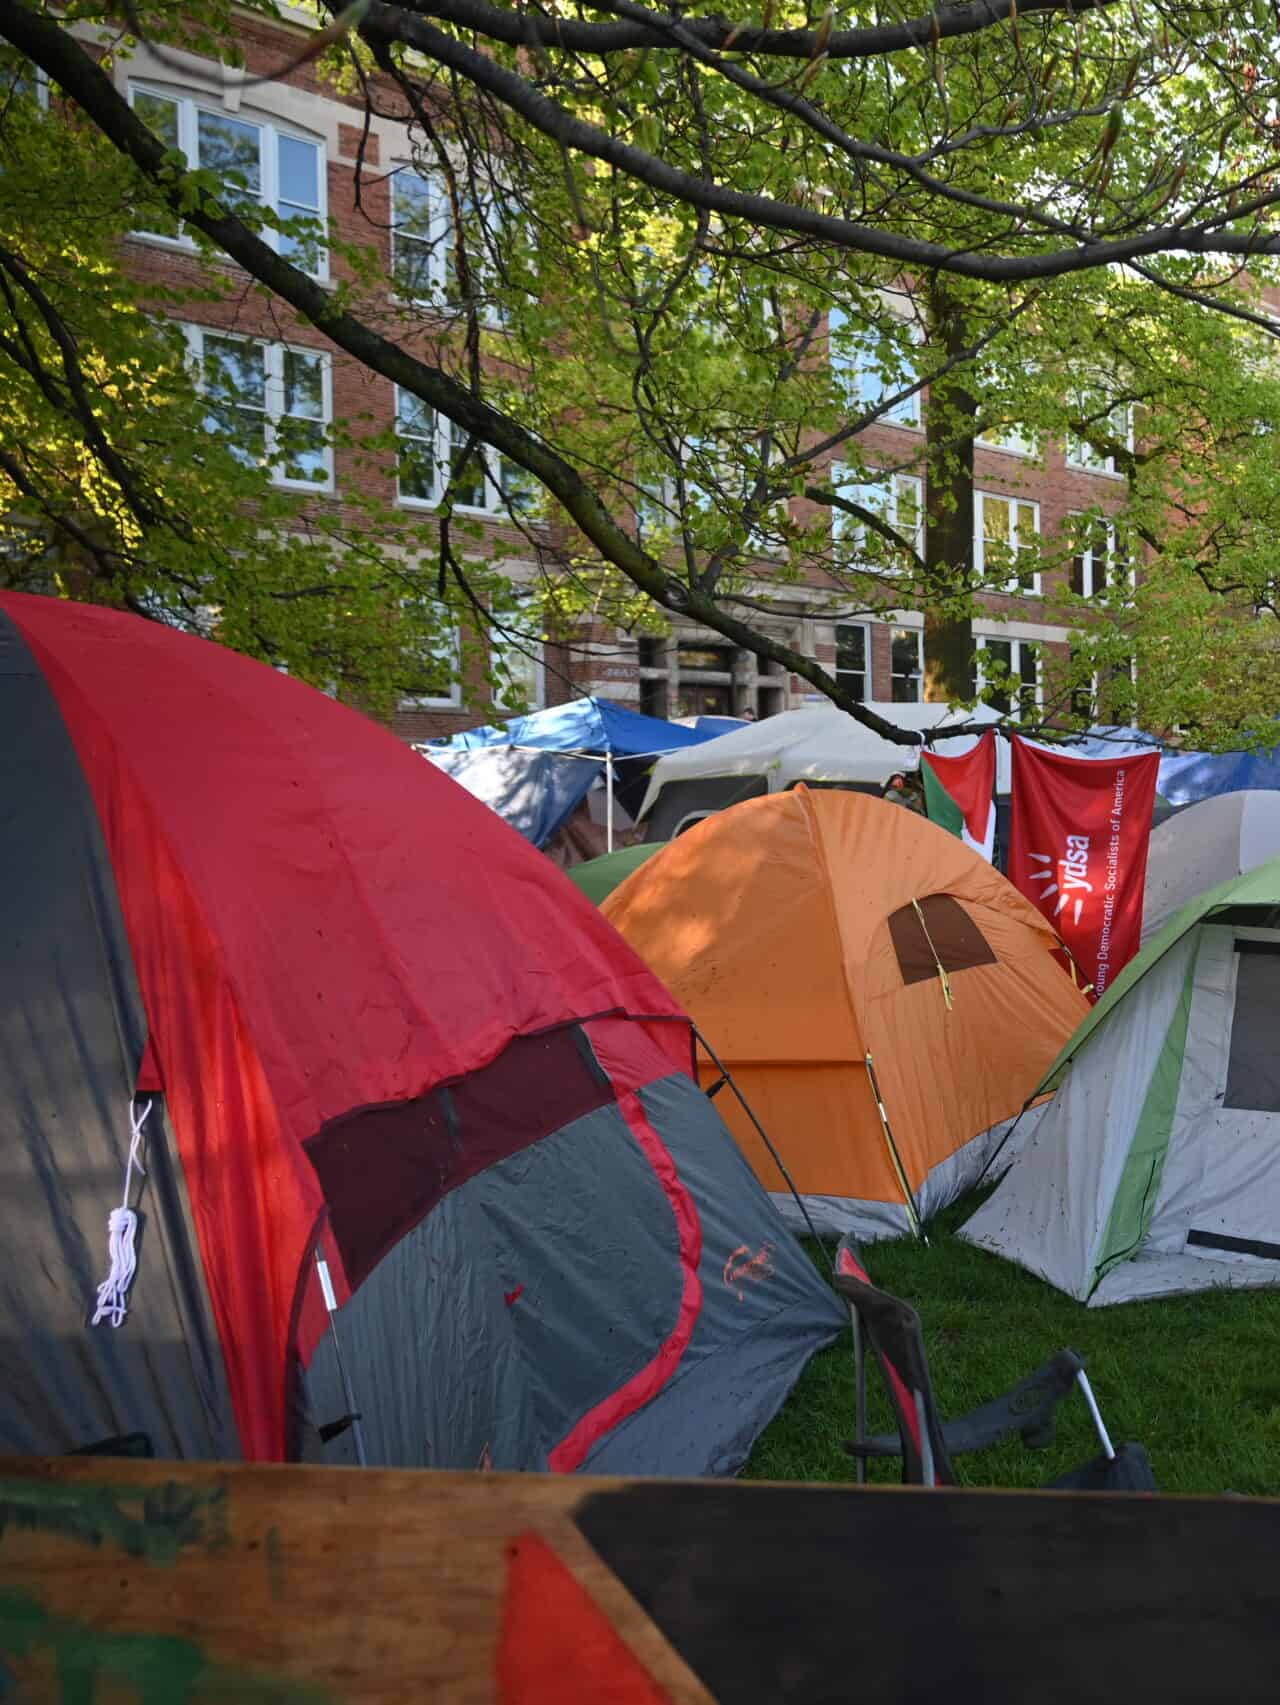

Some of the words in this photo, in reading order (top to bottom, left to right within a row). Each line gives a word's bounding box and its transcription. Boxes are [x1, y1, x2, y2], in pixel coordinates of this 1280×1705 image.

[1111, 769, 1125, 817] America
[1110, 818, 1121, 832] of
[1059, 834, 1093, 893] ydsa
[1104, 834, 1120, 890] Socialists
[1097, 894, 1114, 961] Democratic
